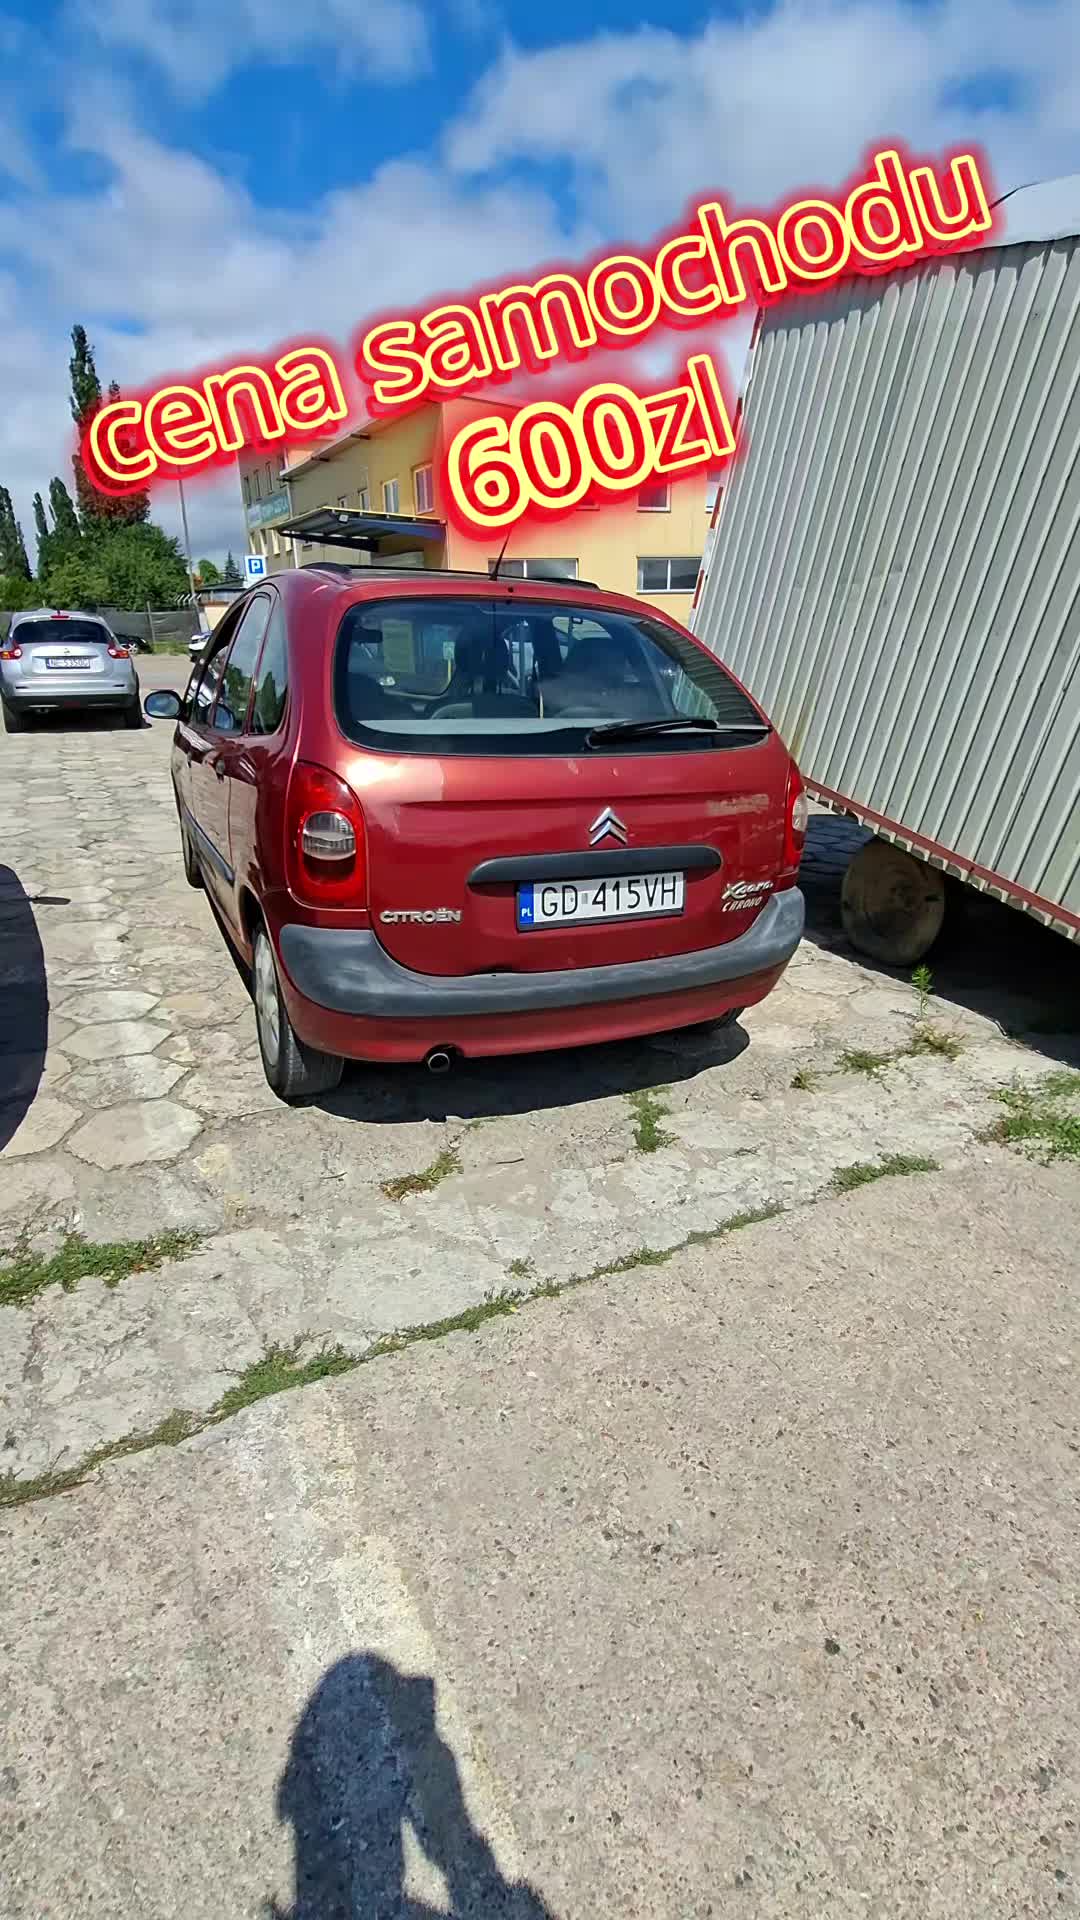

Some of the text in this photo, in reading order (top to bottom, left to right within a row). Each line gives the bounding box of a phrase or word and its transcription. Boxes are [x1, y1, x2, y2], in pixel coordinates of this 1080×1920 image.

[541, 876, 676, 917] GD 415VH
[722, 896, 763, 912] CHRONO
[380, 907, 462, 923] CITROËN
[521, 908, 532, 917] PL
